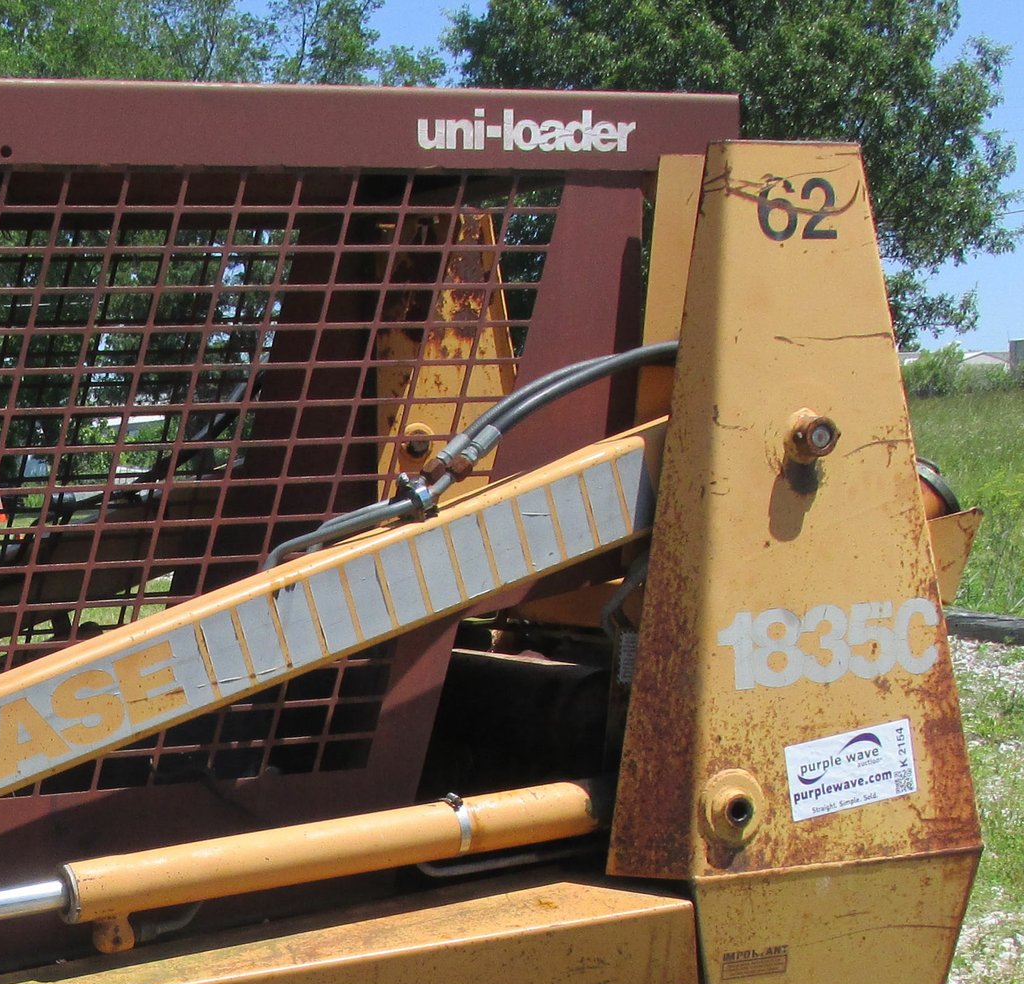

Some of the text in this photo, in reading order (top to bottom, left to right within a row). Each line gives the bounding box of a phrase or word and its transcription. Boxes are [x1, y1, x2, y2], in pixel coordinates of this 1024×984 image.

[417, 108, 636, 152] uni-loader
[757, 177, 838, 241] 62
[717, 598, 939, 690] 1835C
[800, 747, 879, 777] purple wave
[896, 727, 908, 768] K 2154
[794, 770, 893, 804] purplewave.com
[723, 945, 789, 961] IMPORANT
